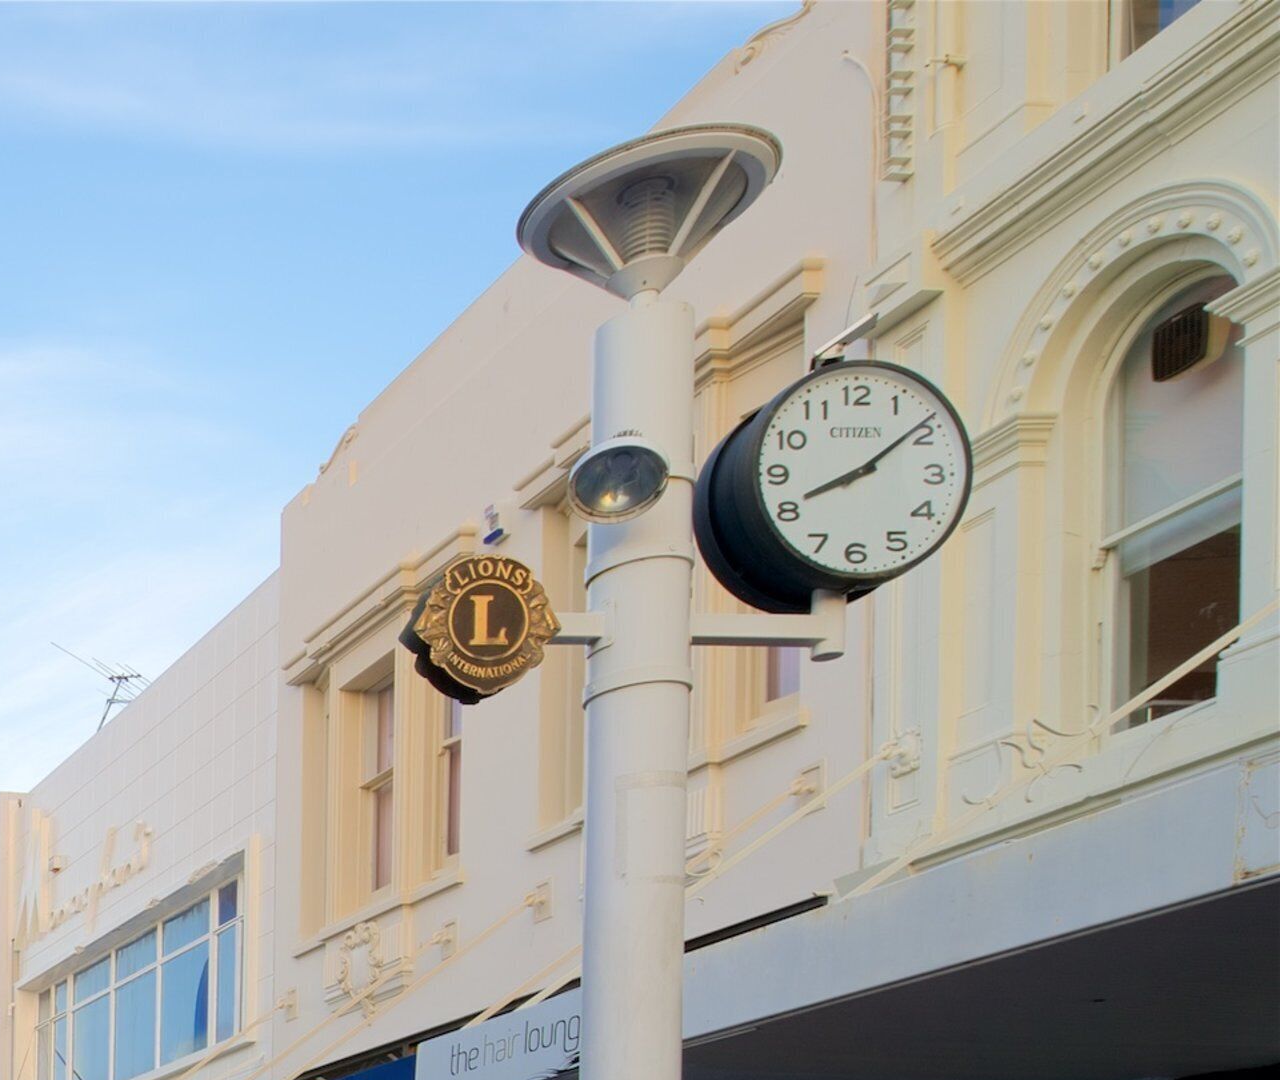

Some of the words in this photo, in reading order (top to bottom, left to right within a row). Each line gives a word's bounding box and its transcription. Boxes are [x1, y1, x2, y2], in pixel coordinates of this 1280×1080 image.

[841, 385, 871, 407] 12
[891, 396, 900, 415] 1
[802, 400, 829, 420] 11
[777, 430, 806, 450] 10
[829, 426, 882, 439] CITIZEN
[912, 425, 935, 445] 2
[766, 465, 790, 485] 9
[923, 464, 946, 485] 3
[776, 501, 800, 522] 8
[910, 501, 936, 520] 4
[807, 534, 828, 554] 7
[885, 532, 907, 551] 5
[844, 543, 867, 564] 6
[453, 560, 527, 586] LIONS
[469, 595, 509, 646] L
[448, 651, 531, 679] INTERNATIONAL
[450, 1043, 479, 1076] the
[483, 1021, 521, 1066] hair
[524, 1013, 581, 1054] loung
